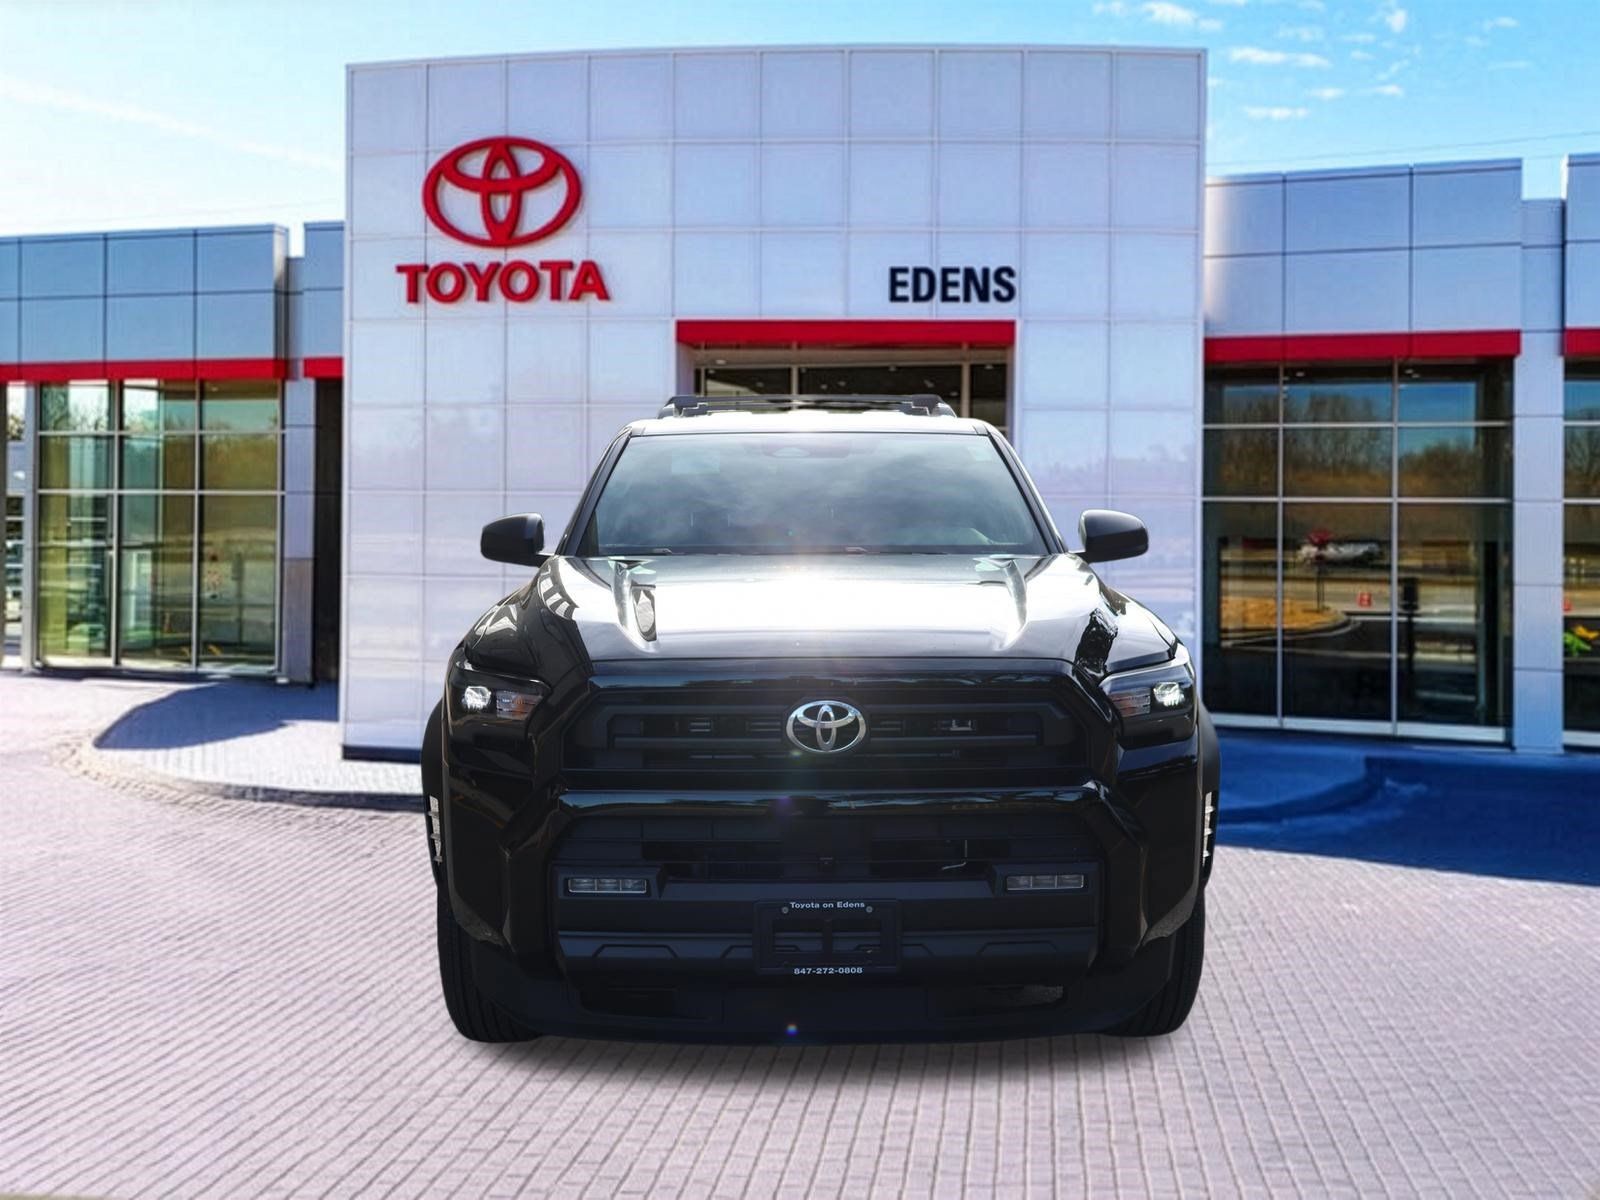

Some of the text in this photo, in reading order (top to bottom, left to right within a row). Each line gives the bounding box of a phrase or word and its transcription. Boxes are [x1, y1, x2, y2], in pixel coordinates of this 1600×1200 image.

[395, 260, 611, 304] TOYOTA
[889, 266, 1016, 303] EDENS
[789, 901, 820, 909] Toyota
[836, 901, 866, 909] Edens
[793, 966, 864, 975] 847-272-0808
